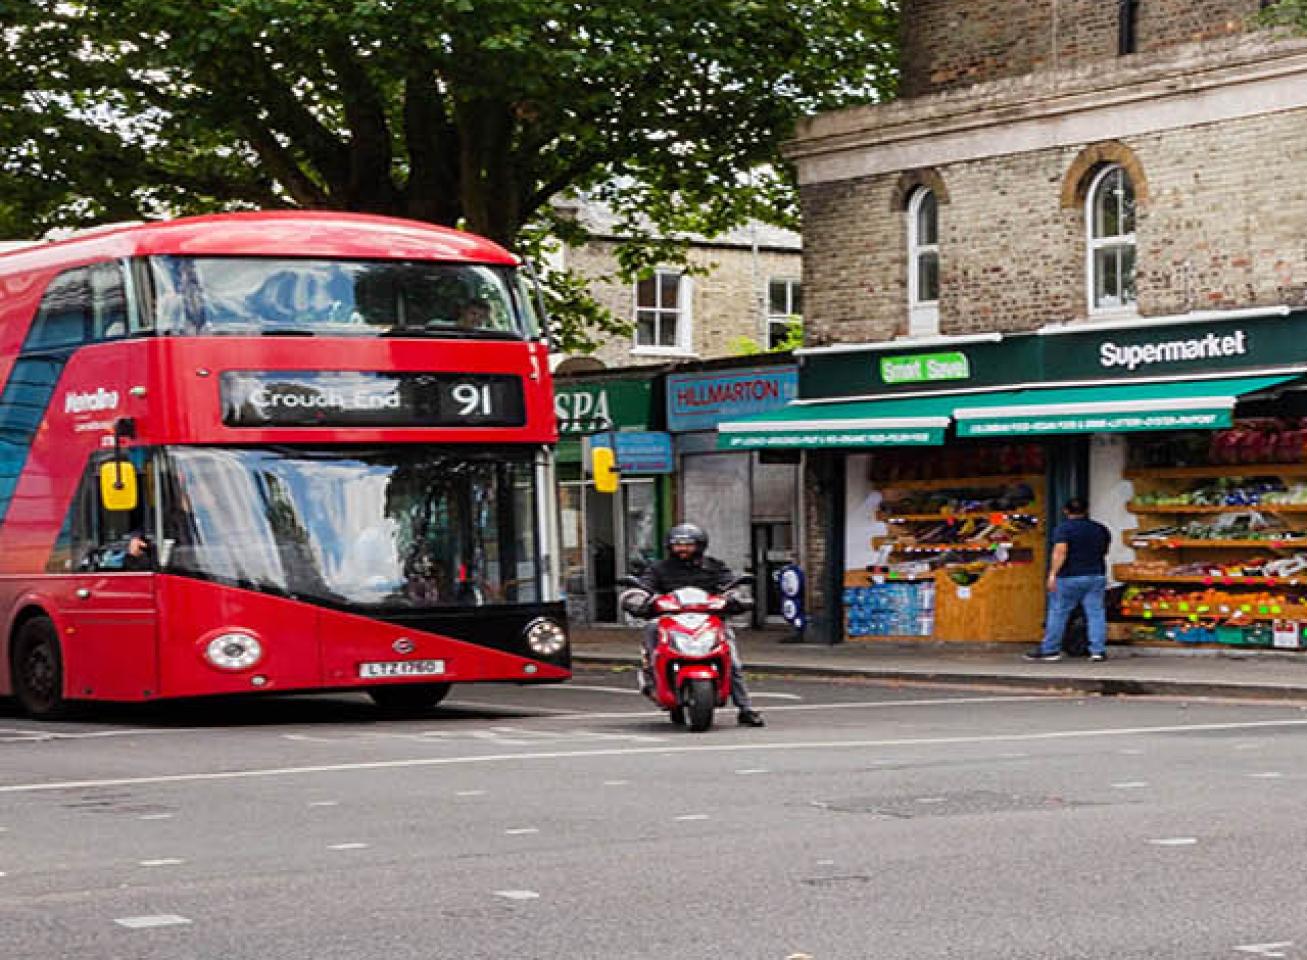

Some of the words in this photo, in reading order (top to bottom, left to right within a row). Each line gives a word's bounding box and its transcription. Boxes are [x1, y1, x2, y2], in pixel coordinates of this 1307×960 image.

[1101, 330, 1246, 370] Supermarket
[252, 385, 343, 408] Crouch
[344, 381, 400, 410] End
[452, 383, 491, 415] 91
[677, 380, 778, 407] HILLMARTON
